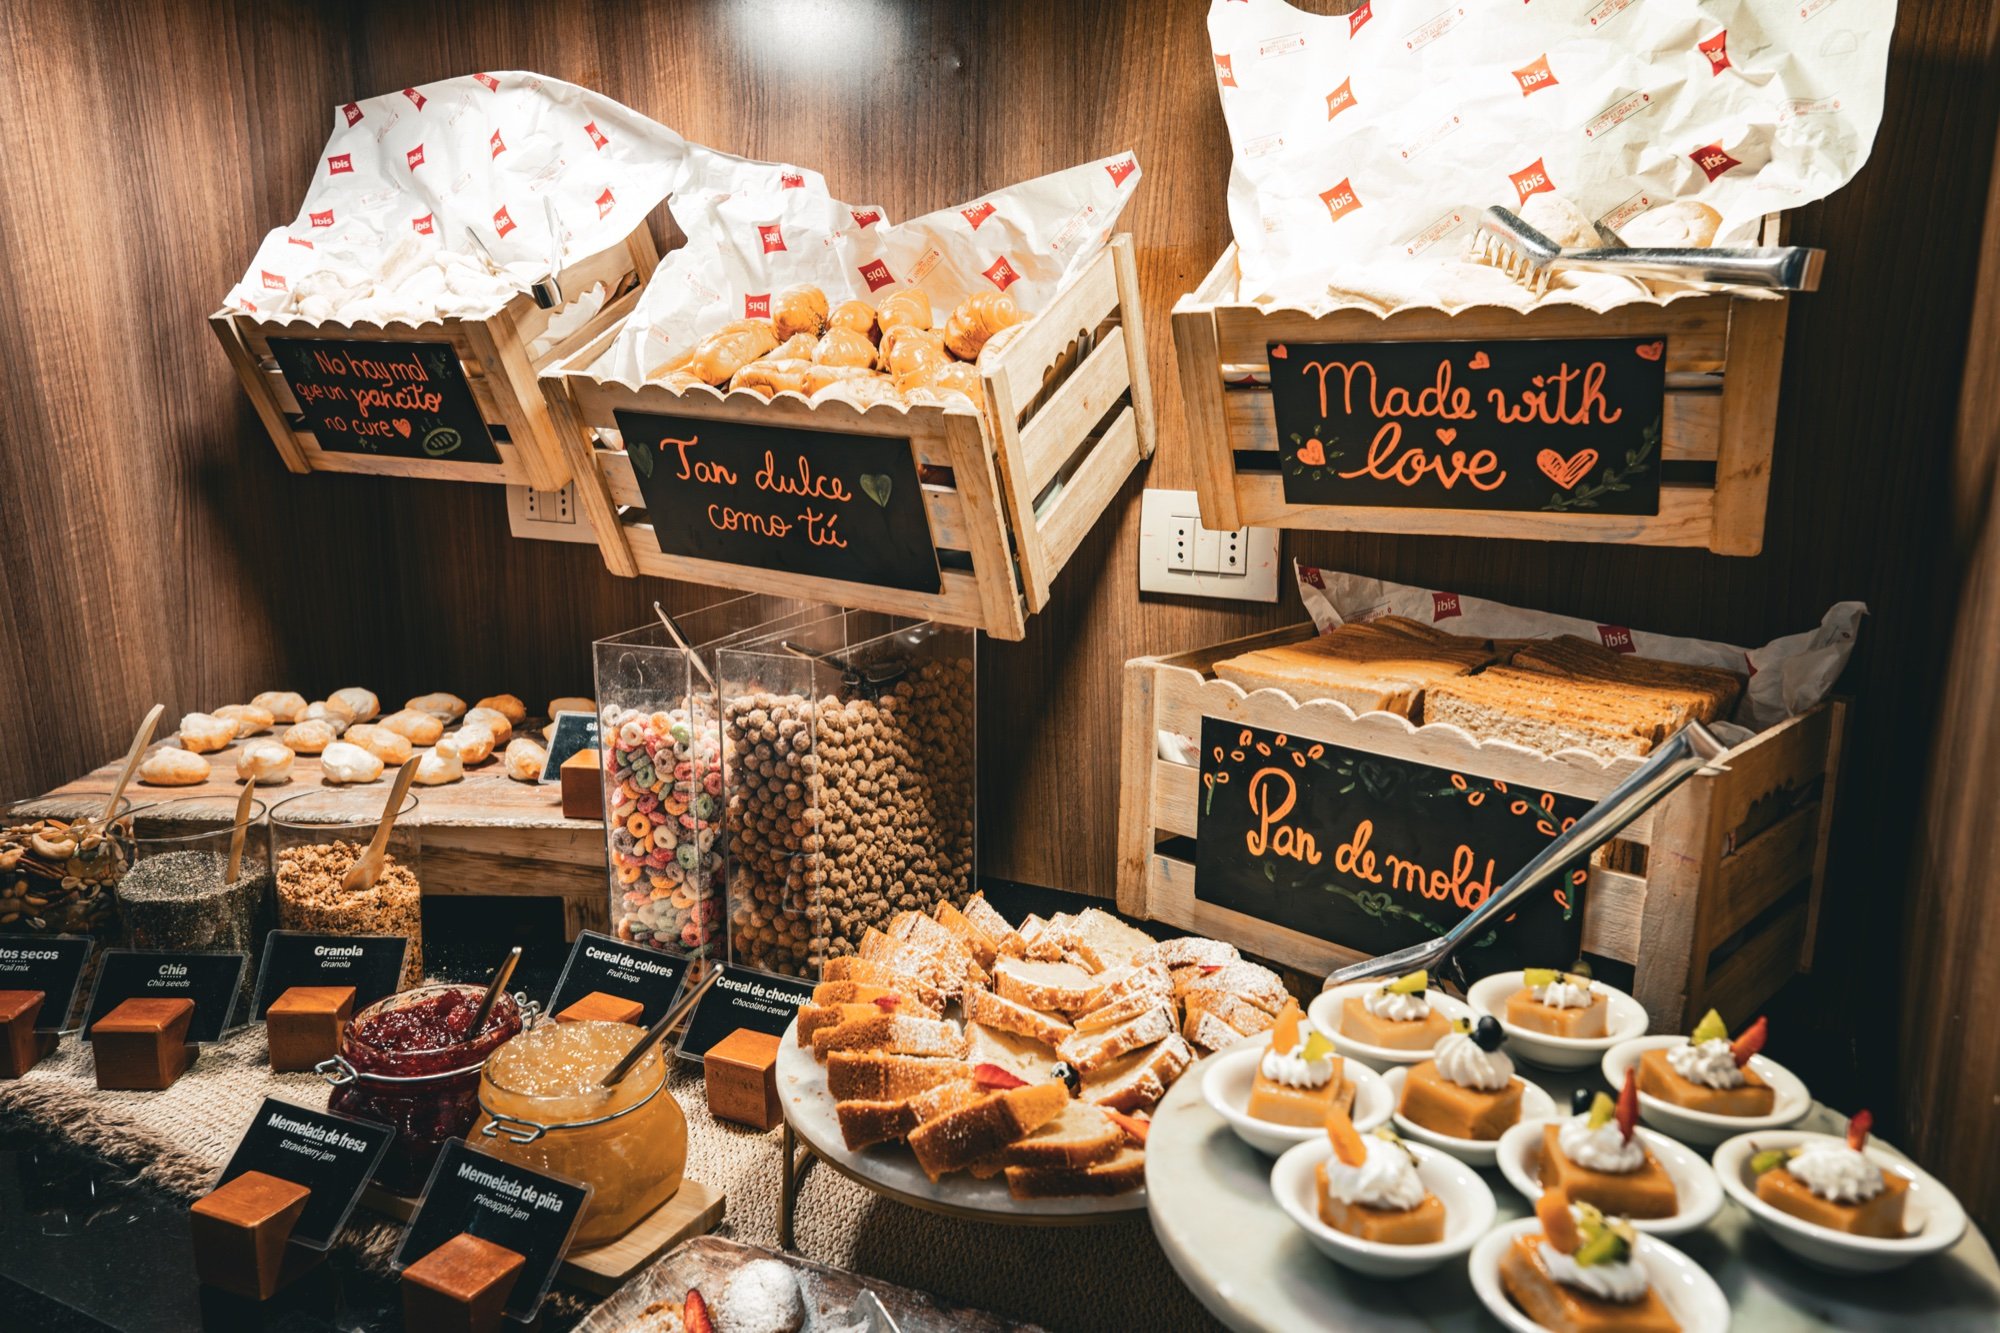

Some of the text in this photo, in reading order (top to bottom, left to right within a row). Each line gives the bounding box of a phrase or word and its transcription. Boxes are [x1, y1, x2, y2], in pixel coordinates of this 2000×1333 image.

[1352, 6, 1369, 29] ibis
[1520, 69, 1549, 87] ibis
[1329, 89, 1349, 110] ibis
[347, 106, 359, 121] ibis
[331, 159, 350, 171] ibis
[409, 152, 422, 165] ibis
[1701, 153, 1728, 171] ibis
[1518, 173, 1545, 195] ibis
[1328, 191, 1353, 212] ibis
[314, 217, 333, 226] ibis
[414, 221, 430, 231] ibis
[496, 215, 510, 230] ibis
[764, 232, 781, 245] ibis
[867, 266, 888, 281] ibis
[992, 264, 1012, 281] ibis
[748, 301, 767, 311] ibis
[313, 350, 429, 387] No hay mal
[296, 382, 443, 418] que un pancito
[1302, 359, 1622, 425] Made with
[324, 415, 395, 438] no cure
[1338, 421, 1507, 491] love
[660, 435, 852, 502] Tan dulce
[707, 504, 848, 548] como tú
[1437, 597, 1457, 613] ibis
[1605, 631, 1629, 648] ibis
[1246, 767, 1503, 912] Pan de mold
[20, 949, 59, 960] secos
[314, 945, 364, 957] Granola
[14, 963, 30, 971] mix
[320, 960, 351, 968] Granola
[585, 946, 673, 977] Cereal de colores
[147, 979, 191, 987] Chia seeds
[606, 968, 641, 983] Fruit loops
[716, 976, 813, 1006] Cereal de chocolat
[732, 997, 791, 1017] Chocolate cereal
[267, 1112, 368, 1153] Mermelada de fresa
[279, 1138, 337, 1163] Strawberry jam
[457, 1162, 564, 1213] Mermelada de piña
[473, 1193, 530, 1221] Pineapple jam
